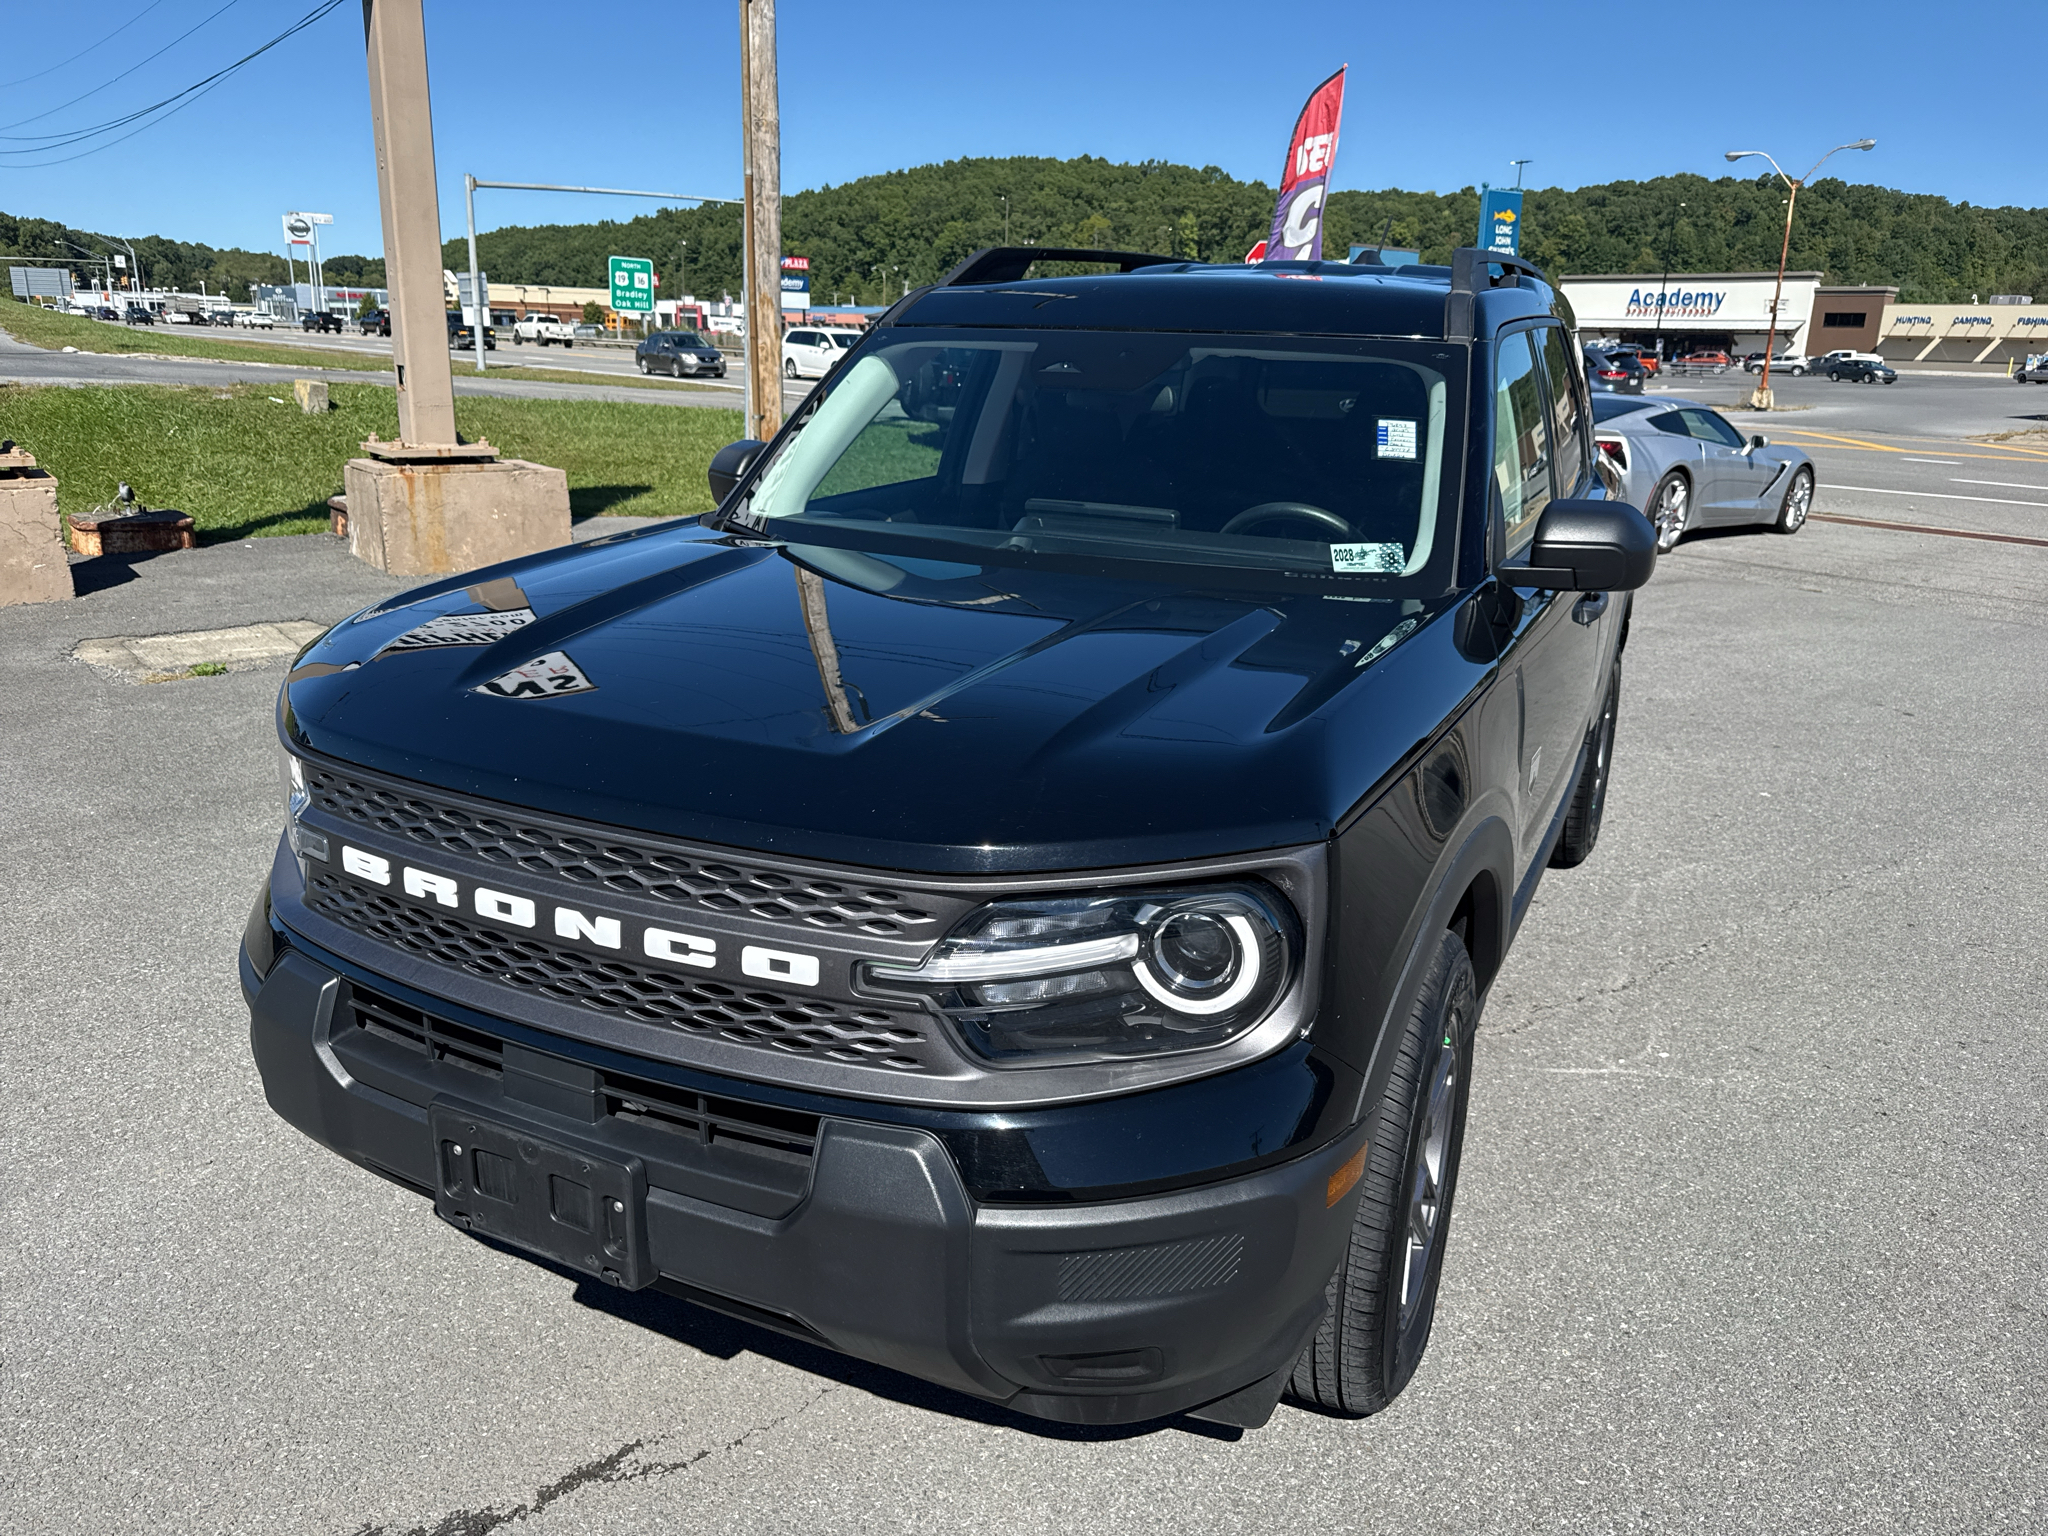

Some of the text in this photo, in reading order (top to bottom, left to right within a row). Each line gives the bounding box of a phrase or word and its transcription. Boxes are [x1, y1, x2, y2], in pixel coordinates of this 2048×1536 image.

[1495, 224, 1512, 235] LONG
[1494, 235, 1511, 245] JOHN
[621, 261, 641, 269] NORTH
[784, 257, 808, 268] PLAZA
[617, 274, 626, 283] 19
[637, 276, 646, 286] 16
[616, 289, 648, 300] Bradley
[1628, 288, 1726, 312] Academy
[615, 299, 649, 309] Oak Hill
[1896, 316, 1931, 325] HUNTING
[1953, 316, 1992, 326] CAMPING
[1333, 548, 1355, 562] 2028
[341, 844, 820, 987] BRONCO
